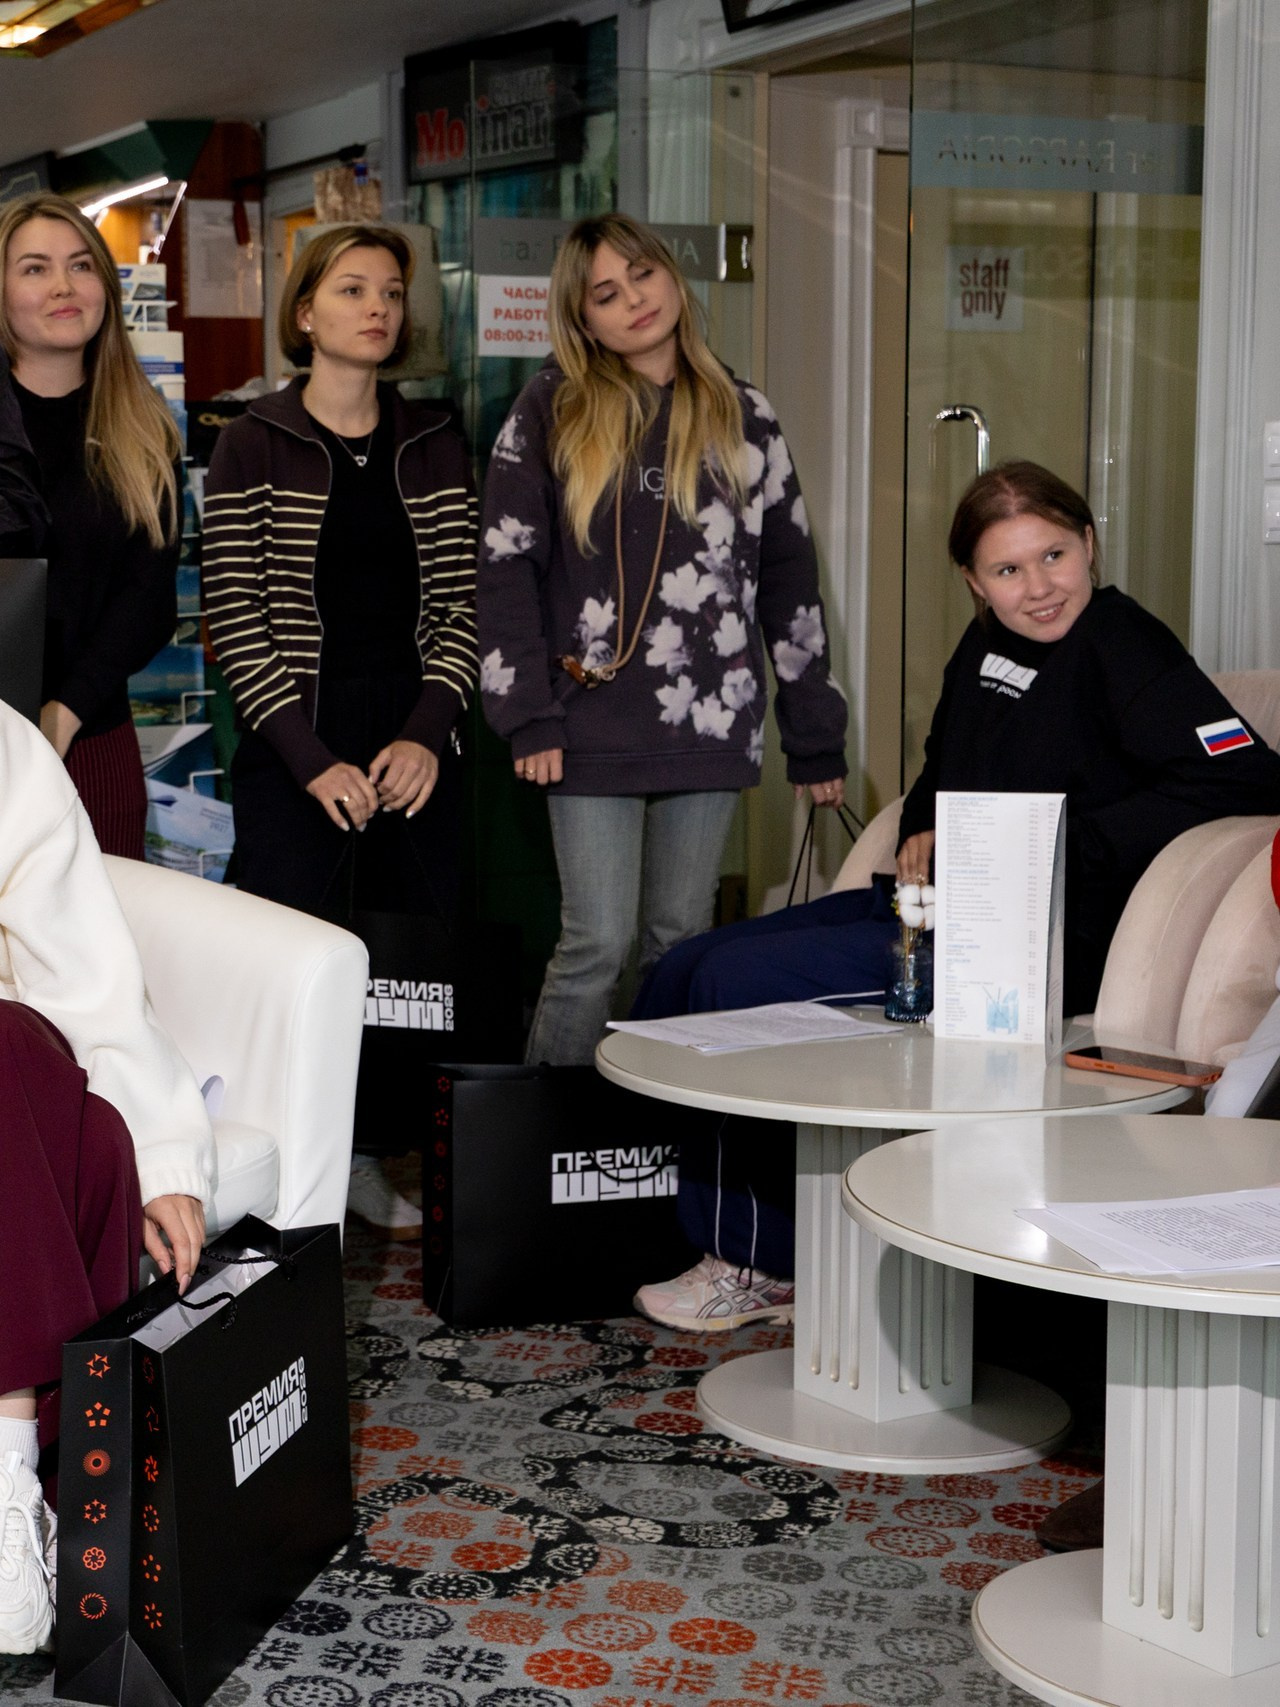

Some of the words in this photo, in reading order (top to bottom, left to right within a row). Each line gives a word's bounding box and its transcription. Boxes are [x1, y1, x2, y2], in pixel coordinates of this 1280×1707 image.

[959, 257, 1010, 288] staff
[503, 286, 548, 300] ЧАСЫ
[961, 287, 1007, 320] only
[484, 328, 550, 342] 08:00-21:
[366, 978, 444, 1002] РЕМИЯ
[443, 984, 454, 1032] 2026
[228, 1360, 300, 1444] ПРЕМИЯ
[232, 1387, 303, 1488] ШУМ
